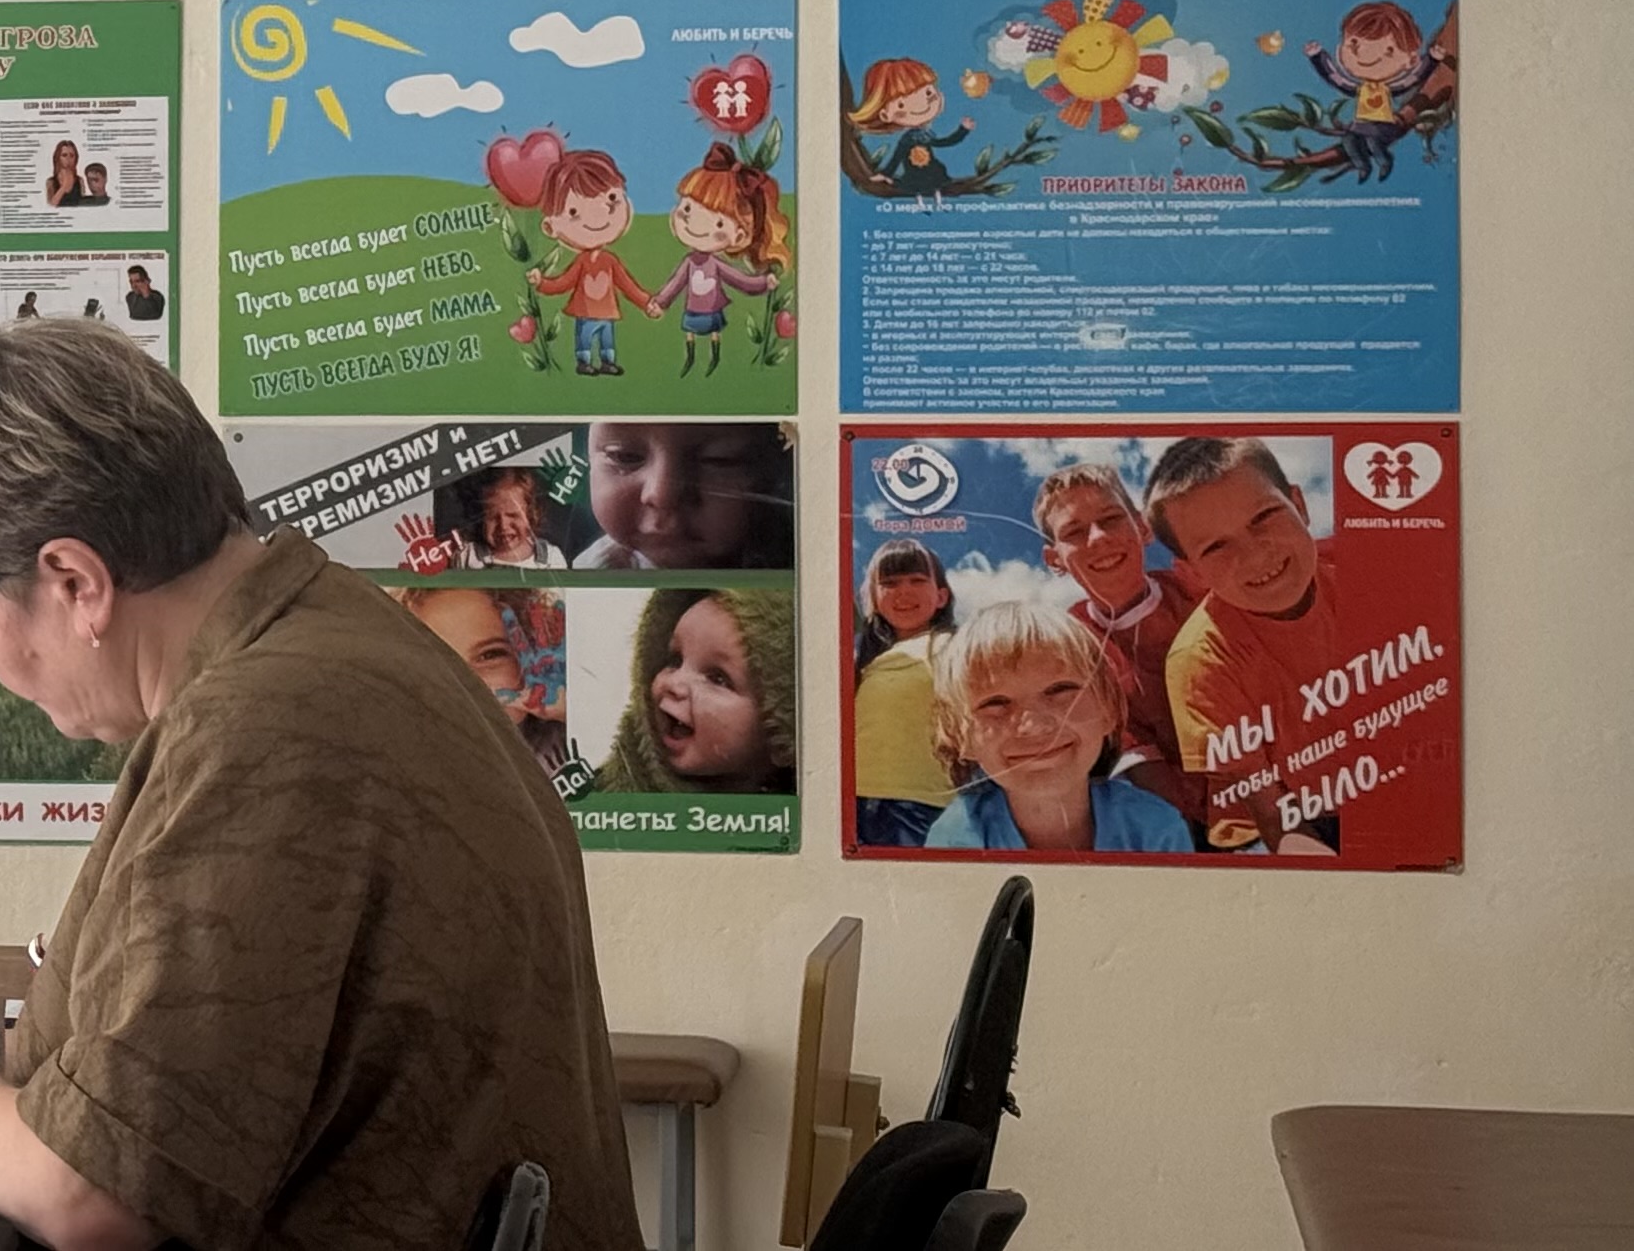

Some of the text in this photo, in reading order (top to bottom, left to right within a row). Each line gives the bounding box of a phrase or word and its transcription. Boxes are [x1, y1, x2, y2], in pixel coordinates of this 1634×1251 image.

[671, 26, 794, 42] ЛЮБИТЬ И БЕРЕЧЬ
[1042, 174, 1247, 195] ПРИОРИТЕТЫ ЗАКОНА
[228, 249, 285, 277] Пусть
[290, 235, 352, 262] всегда
[357, 224, 408, 254] будет
[236, 291, 293, 318] Пусть
[298, 277, 359, 304] всегда
[365, 266, 416, 295] будет
[243, 333, 300, 360] Пусть
[306, 318, 368, 347] всегда
[373, 308, 424, 337] будет
[251, 335, 482, 399] ПУСТЬ ВСЕГДА БУДУ Я!
[259, 426, 468, 523] ТЕРРОРИЗМУ и
[292, 463, 433, 540] РЕМИЗМУ
[455, 428, 523, 474] НЕТ!
[549, 454, 591, 505] Нет!
[1343, 517, 1445, 529] ЛЮБИТЬ И БЕРЕЧЬ
[407, 528, 466, 573] Нет!
[1205, 703, 1276, 773] МЫ
[1212, 676, 1449, 809] чтобы наше будущее
[551, 756, 595, 798] Да!
[1275, 754, 1406, 832] БЫЛО...
[41, 801, 107, 823] жиз
[569, 805, 791, 834] ланеты Земля!
